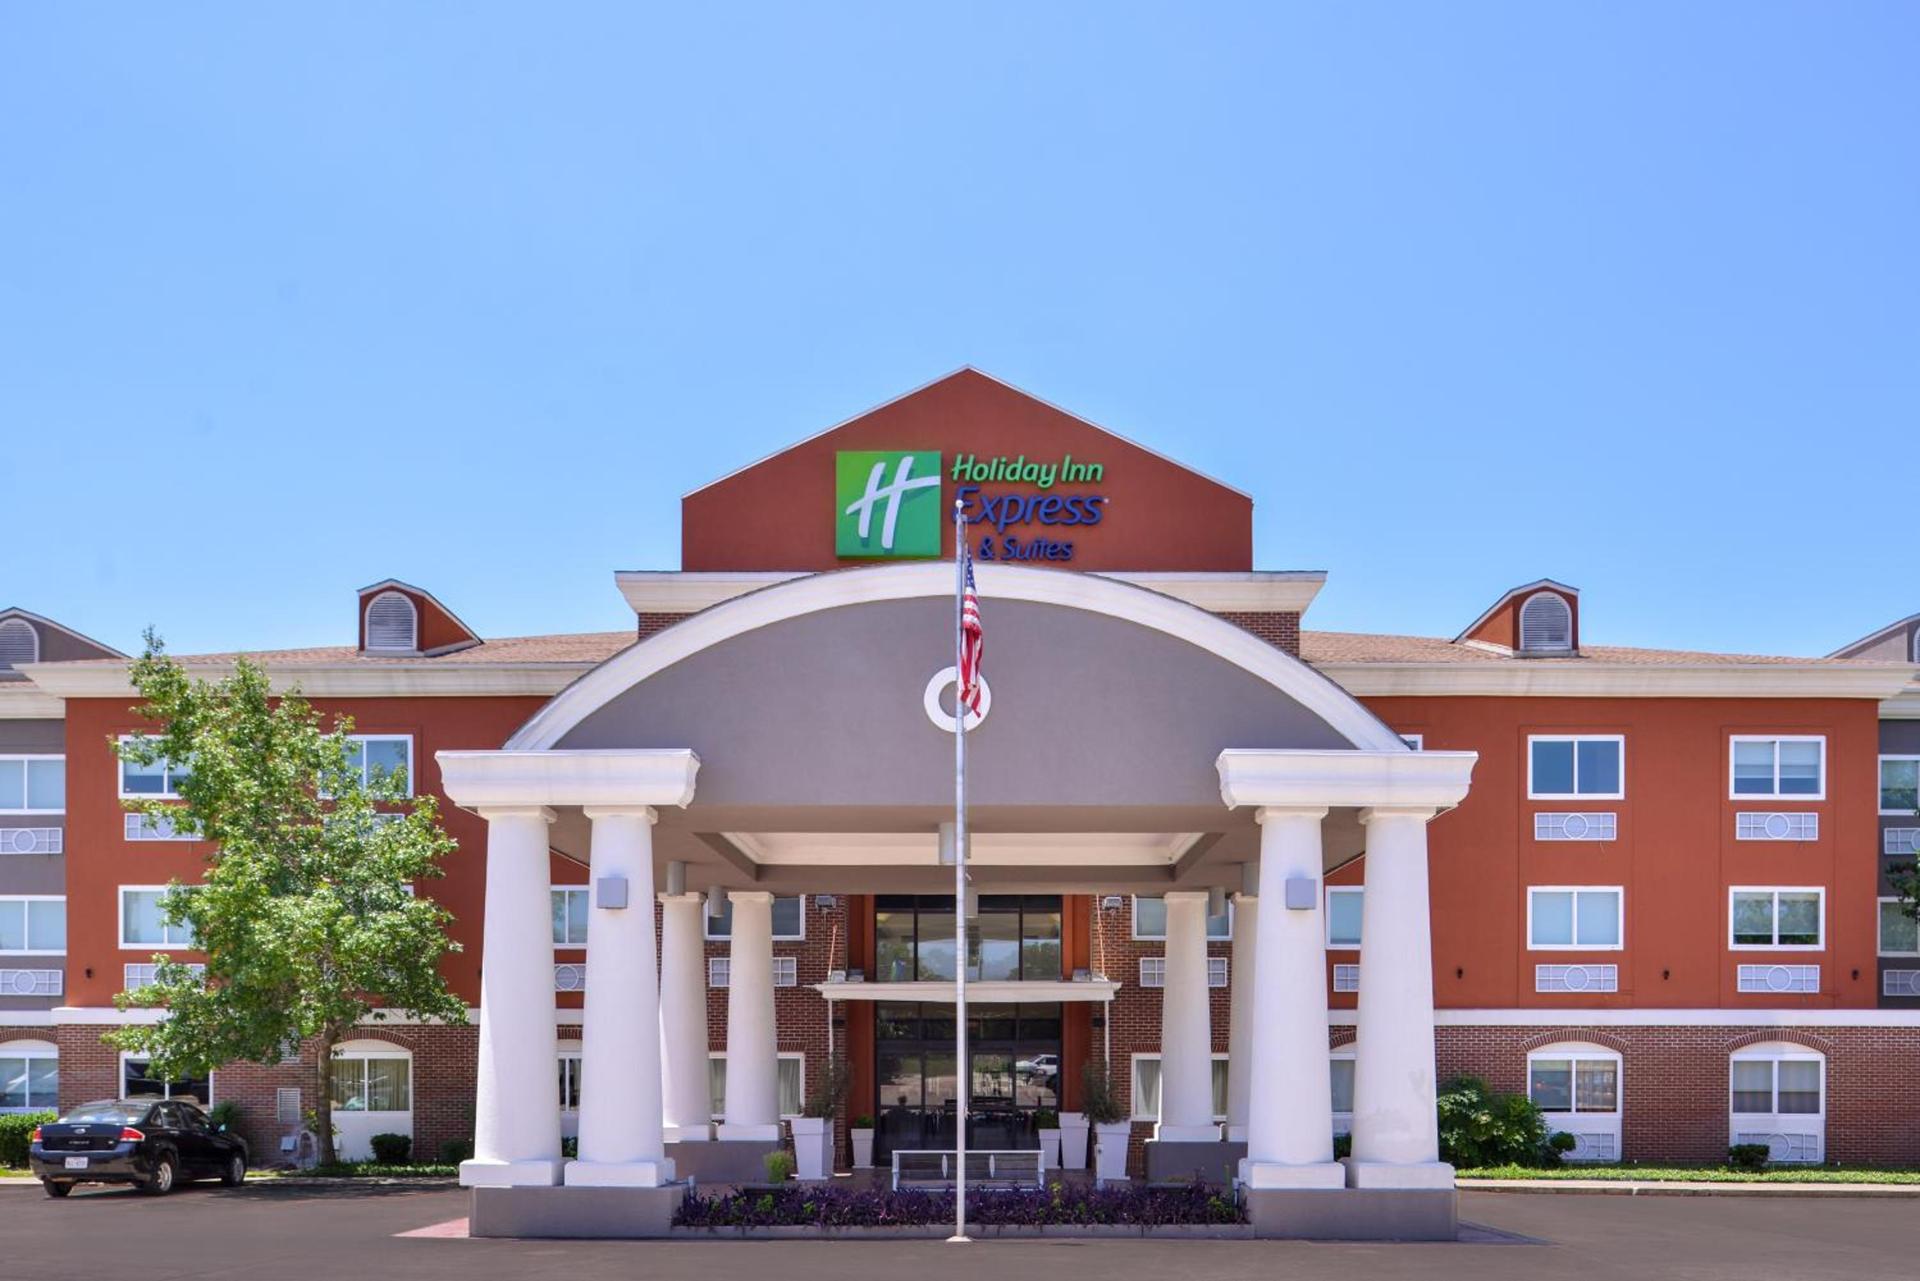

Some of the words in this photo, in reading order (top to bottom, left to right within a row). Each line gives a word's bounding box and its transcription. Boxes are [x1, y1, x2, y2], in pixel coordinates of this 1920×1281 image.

[952, 454, 1057, 488] Holiday
[1061, 454, 1103, 482] Inn
[953, 486, 1102, 533] Express
[979, 536, 995, 560] &
[1001, 536, 1073, 560] Suites
